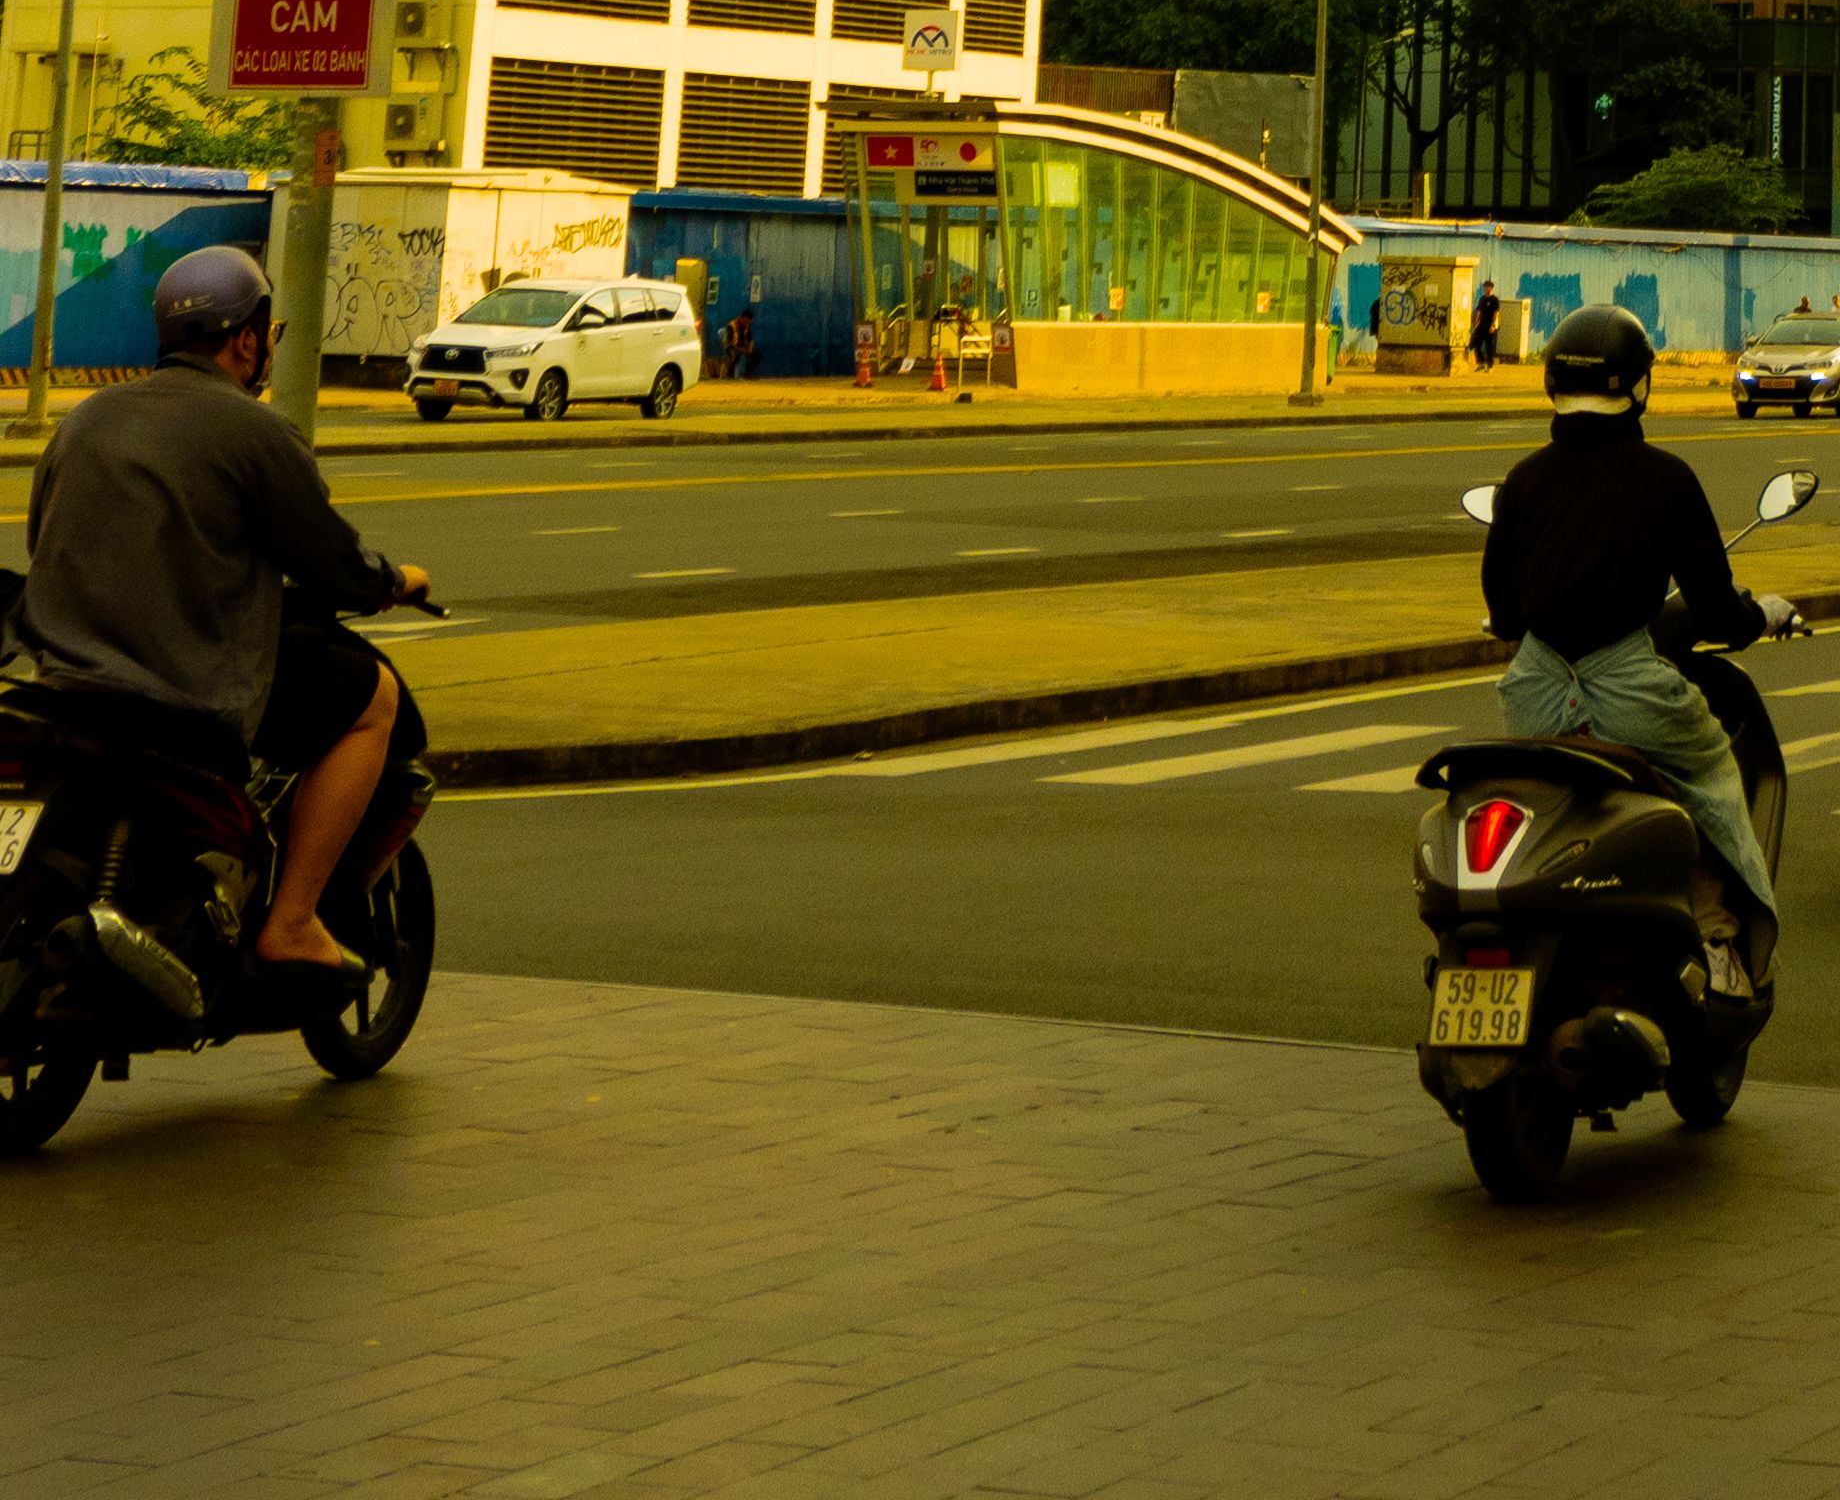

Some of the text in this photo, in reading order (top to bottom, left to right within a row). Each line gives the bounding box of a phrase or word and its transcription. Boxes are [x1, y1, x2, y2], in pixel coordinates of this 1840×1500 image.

[235, 44, 260, 73] CÁC
[294, 50, 311, 73] XE
[312, 50, 328, 72] 02
[330, 43, 366, 73] BÁNH
[1772, 75, 1782, 160] STARBUCKS
[1448, 973, 1520, 1005] 59-U2
[1435, 1009, 1521, 1041] 619.98
